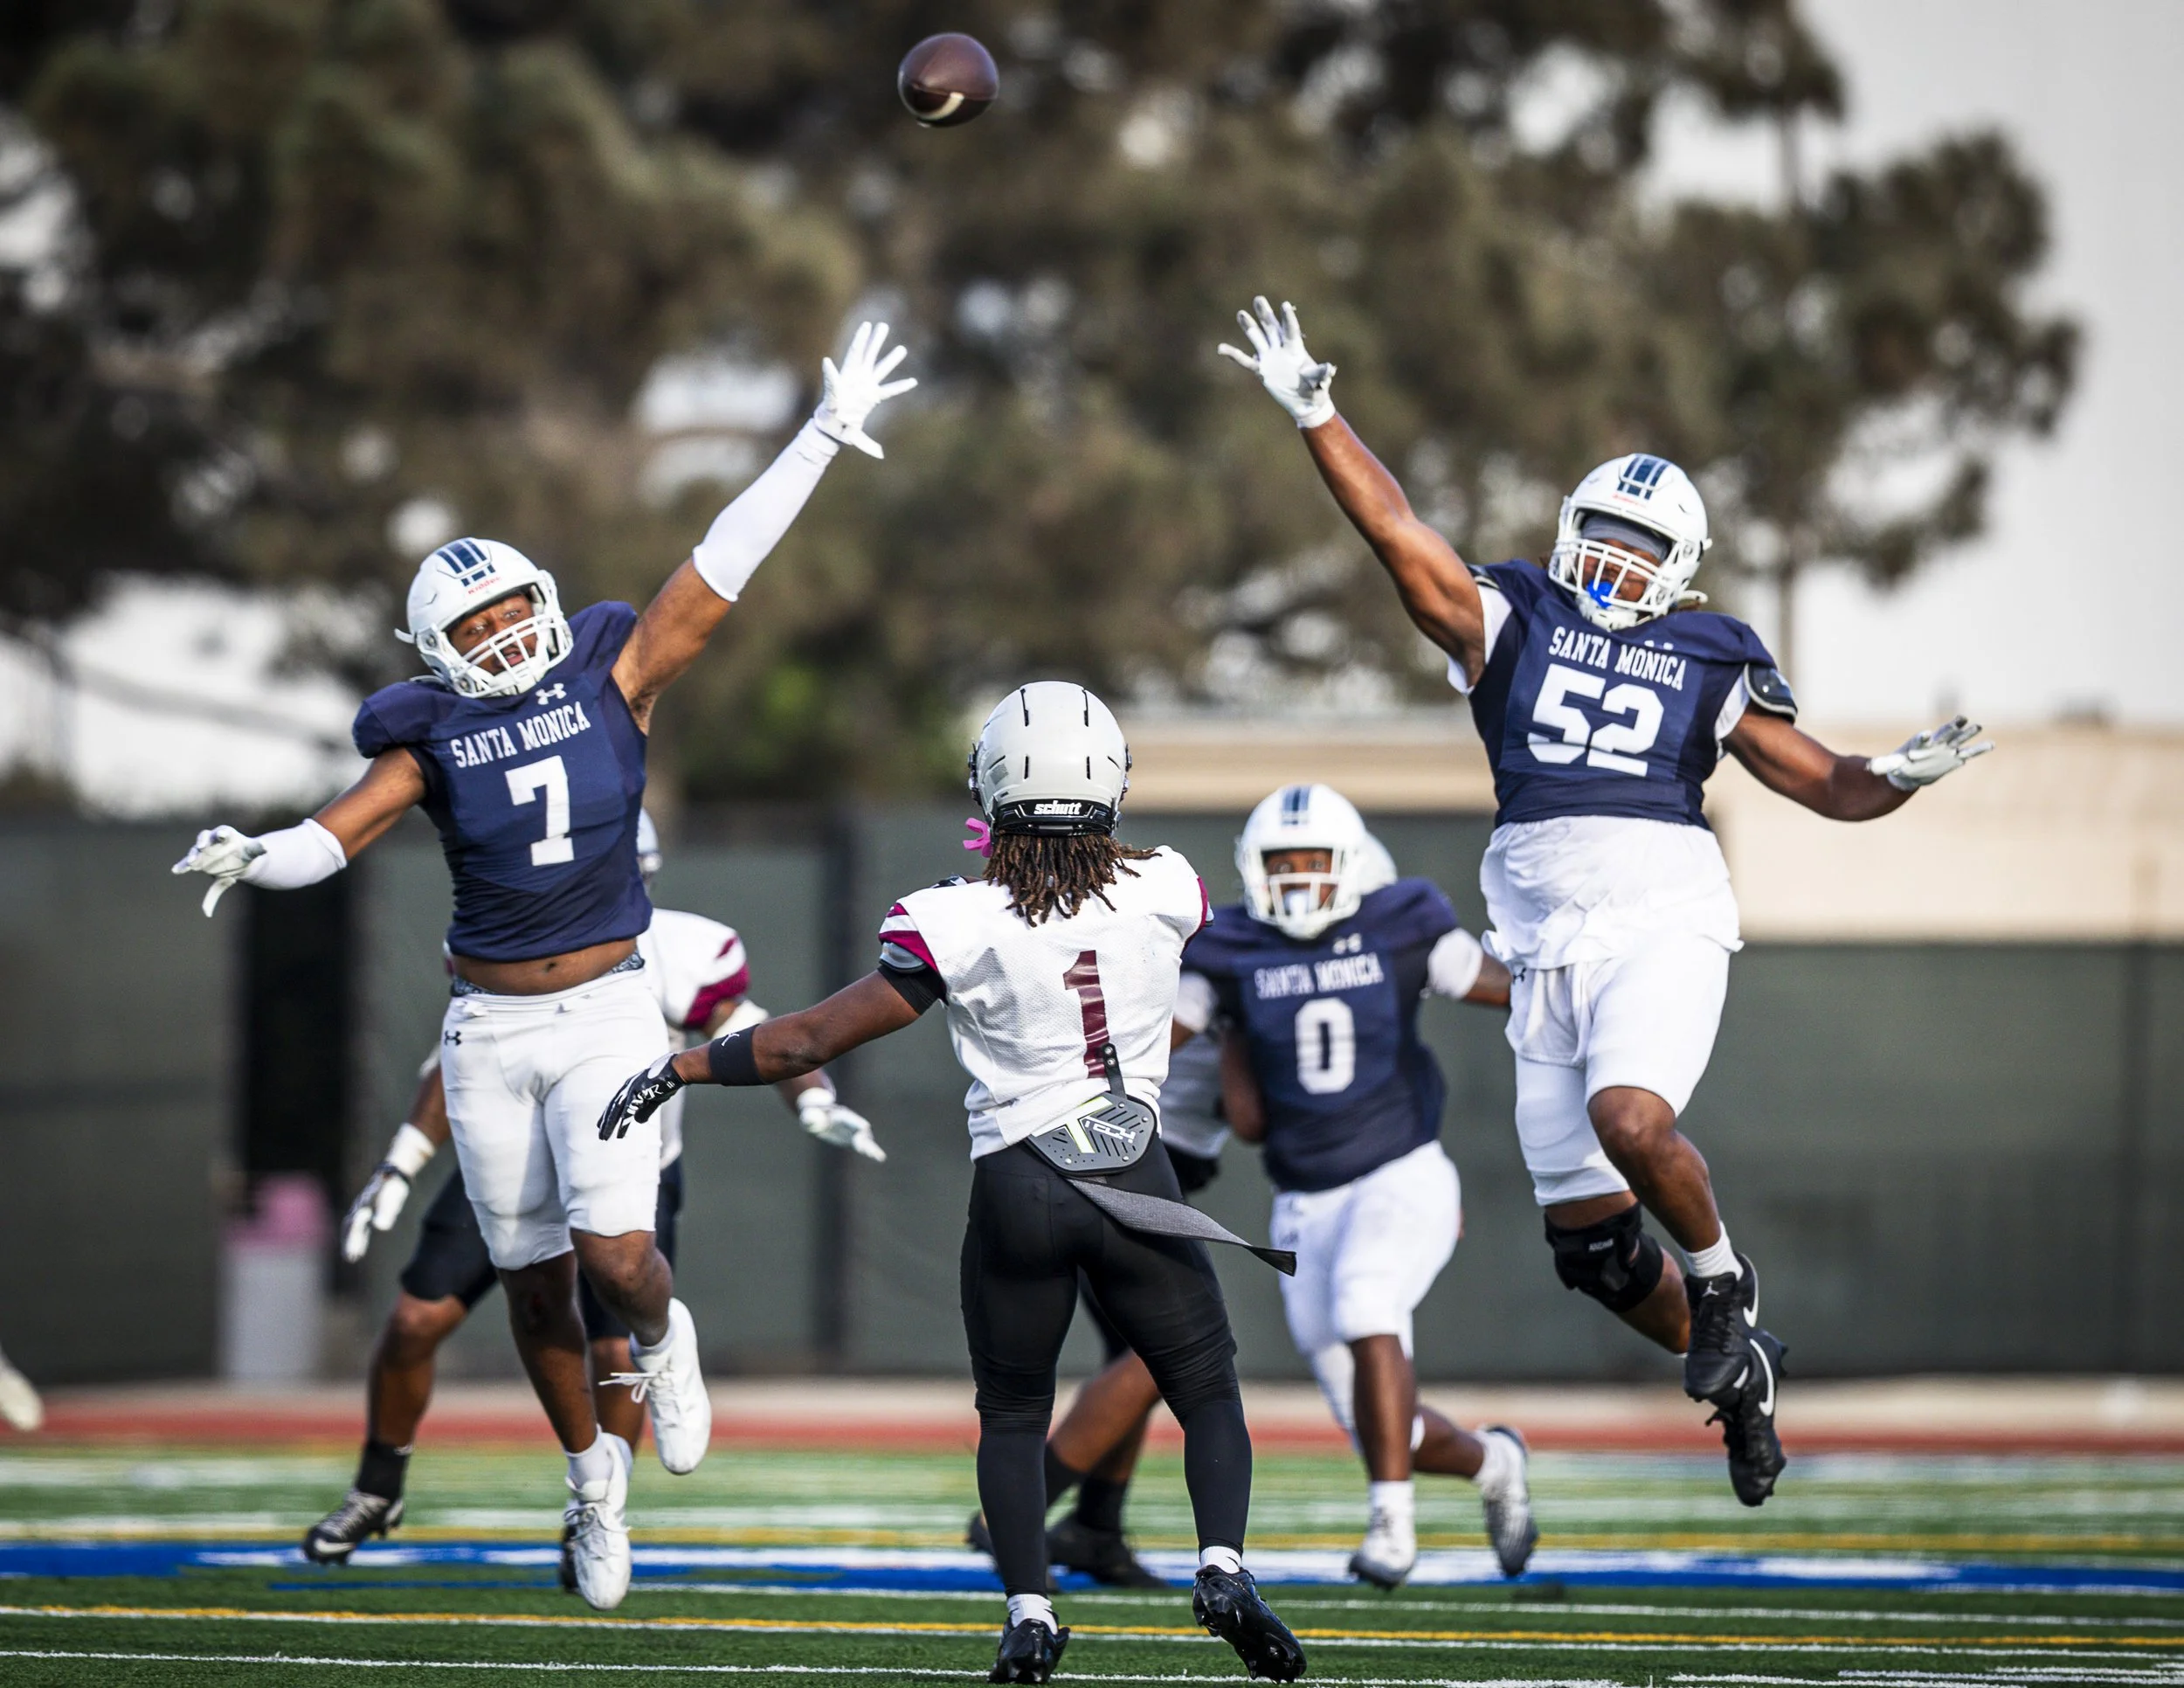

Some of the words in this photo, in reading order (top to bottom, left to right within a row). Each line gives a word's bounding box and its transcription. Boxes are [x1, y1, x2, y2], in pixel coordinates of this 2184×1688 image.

[1548, 626, 1611, 669] SANTA
[1614, 643, 1687, 691] MONICA
[450, 726, 518, 768] SANTA
[516, 701, 591, 751] MONICA
[1527, 663, 1664, 777] 52
[504, 755, 575, 866] 7
[1033, 799, 1082, 815] schutt
[1062, 949, 1110, 1079] 1
[1294, 996, 1357, 1095] 0
